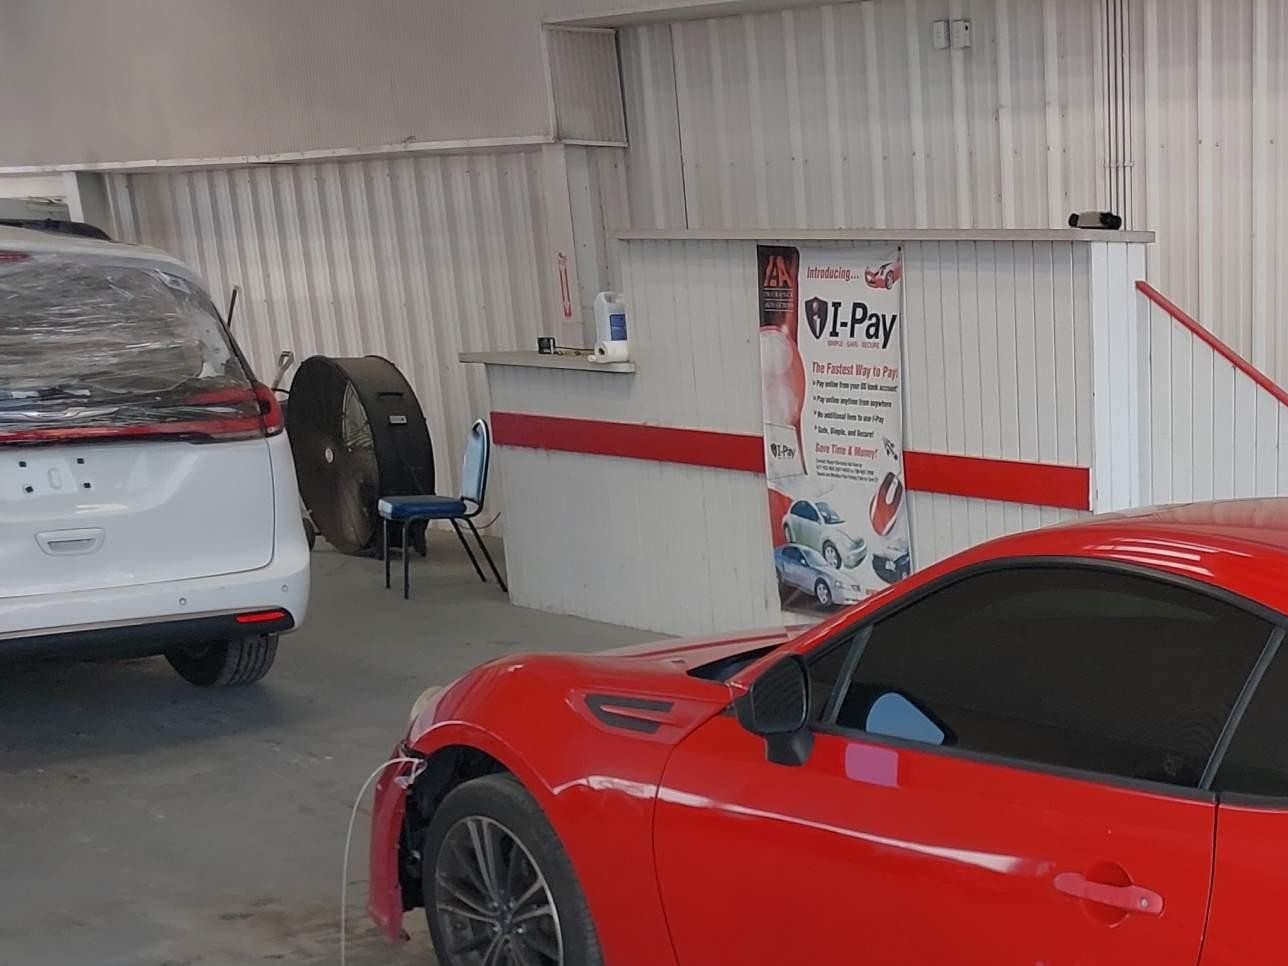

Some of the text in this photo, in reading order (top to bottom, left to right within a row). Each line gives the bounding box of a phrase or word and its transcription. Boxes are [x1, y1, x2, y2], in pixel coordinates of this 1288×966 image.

[807, 266, 860, 282] Introducing...
[829, 301, 898, 349] I-Pay
[812, 361, 825, 374] The
[826, 362, 854, 376] Fastest
[855, 364, 872, 379] Way
[873, 365, 880, 377] to
[815, 442, 830, 454] Save
[831, 444, 846, 455] Time
[847, 446, 853, 456] &
